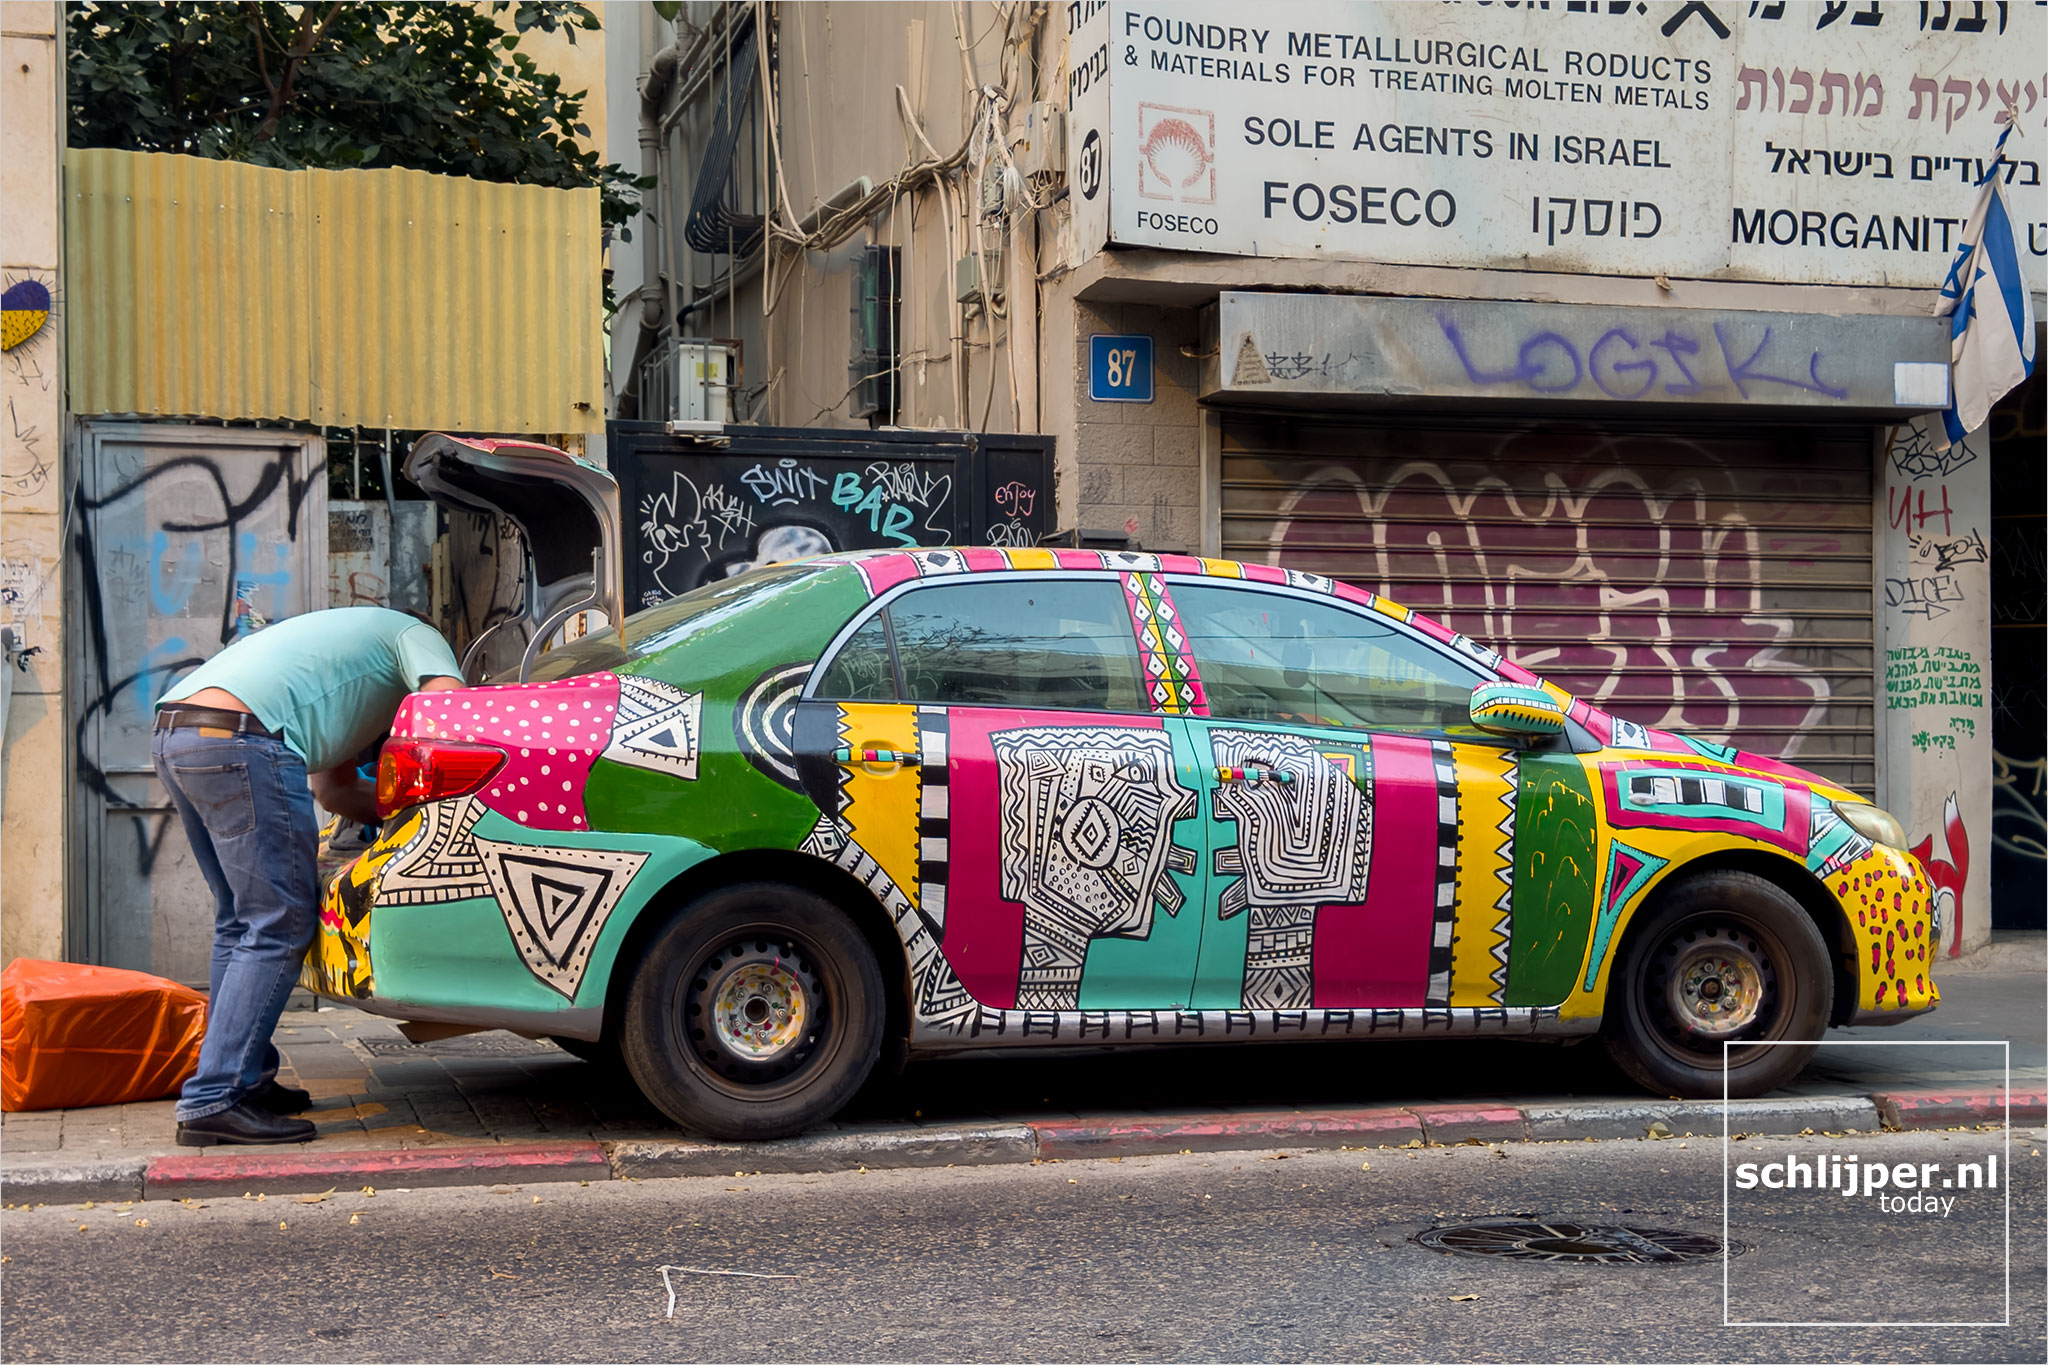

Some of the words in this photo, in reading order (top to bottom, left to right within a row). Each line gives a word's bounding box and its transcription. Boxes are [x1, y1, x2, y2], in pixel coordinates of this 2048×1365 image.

[1124, 12, 1270, 54] FOUNDRY
[1288, 31, 1549, 74] METALLURGICAL
[1565, 51, 1712, 84] RODUCTS
[1124, 44, 1138, 67] &
[1151, 49, 1291, 84] MATERIALS
[1304, 66, 1355, 88] FOR
[1369, 69, 1493, 97] TREATING
[1505, 78, 1602, 103] MOLTEN
[1614, 85, 1709, 111] METALS
[1736, 66, 1884, 117] מתכות
[1081, 137, 1101, 193] 87
[1244, 116, 1335, 150] SOLE
[1352, 123, 1493, 159] AGENTS
[1509, 133, 1539, 161] IN
[1554, 135, 1672, 169] ISRAEL
[1765, 141, 1894, 179] בישראל
[1137, 211, 1219, 236] FOSECO
[1263, 181, 1457, 229] FOSECO
[1532, 196, 1663, 247] פוסקו
[1731, 207, 1970, 254] MORGANIT
[1107, 348, 1137, 388] 87
